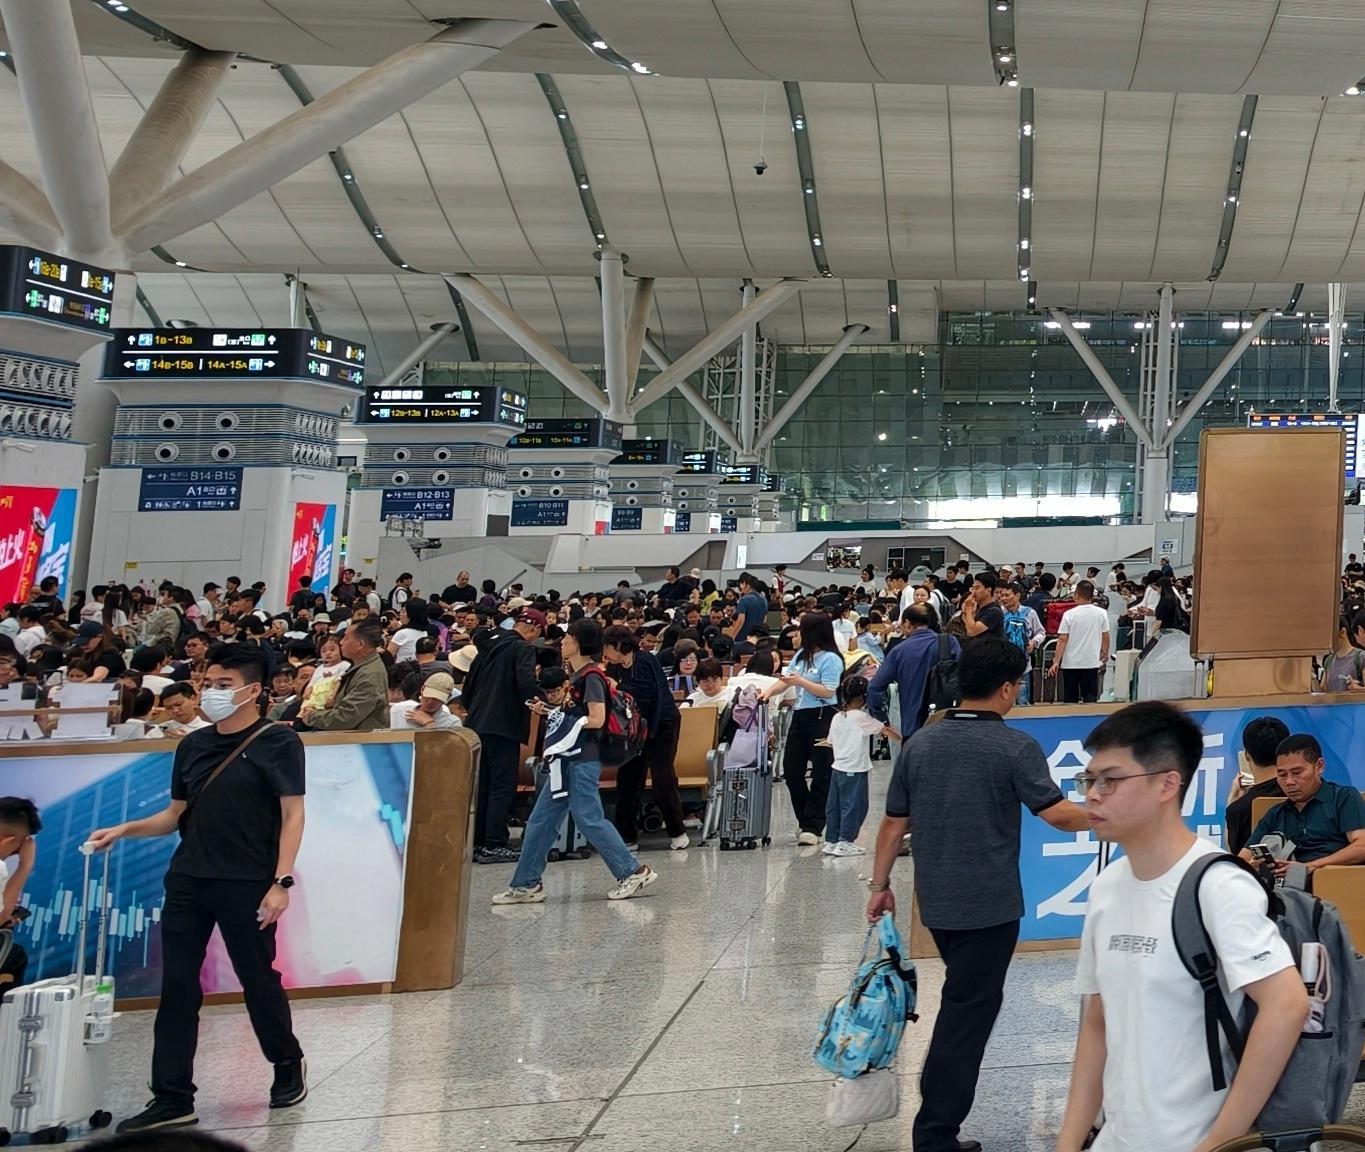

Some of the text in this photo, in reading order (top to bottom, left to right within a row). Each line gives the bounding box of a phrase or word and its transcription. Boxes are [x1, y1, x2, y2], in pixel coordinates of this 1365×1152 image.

[154, 335, 193, 346] 1B-13B
[152, 359, 248, 370] 14B-15B 14A-15A
[186, 486, 202, 497] A1
[414, 502, 427, 510] A1
